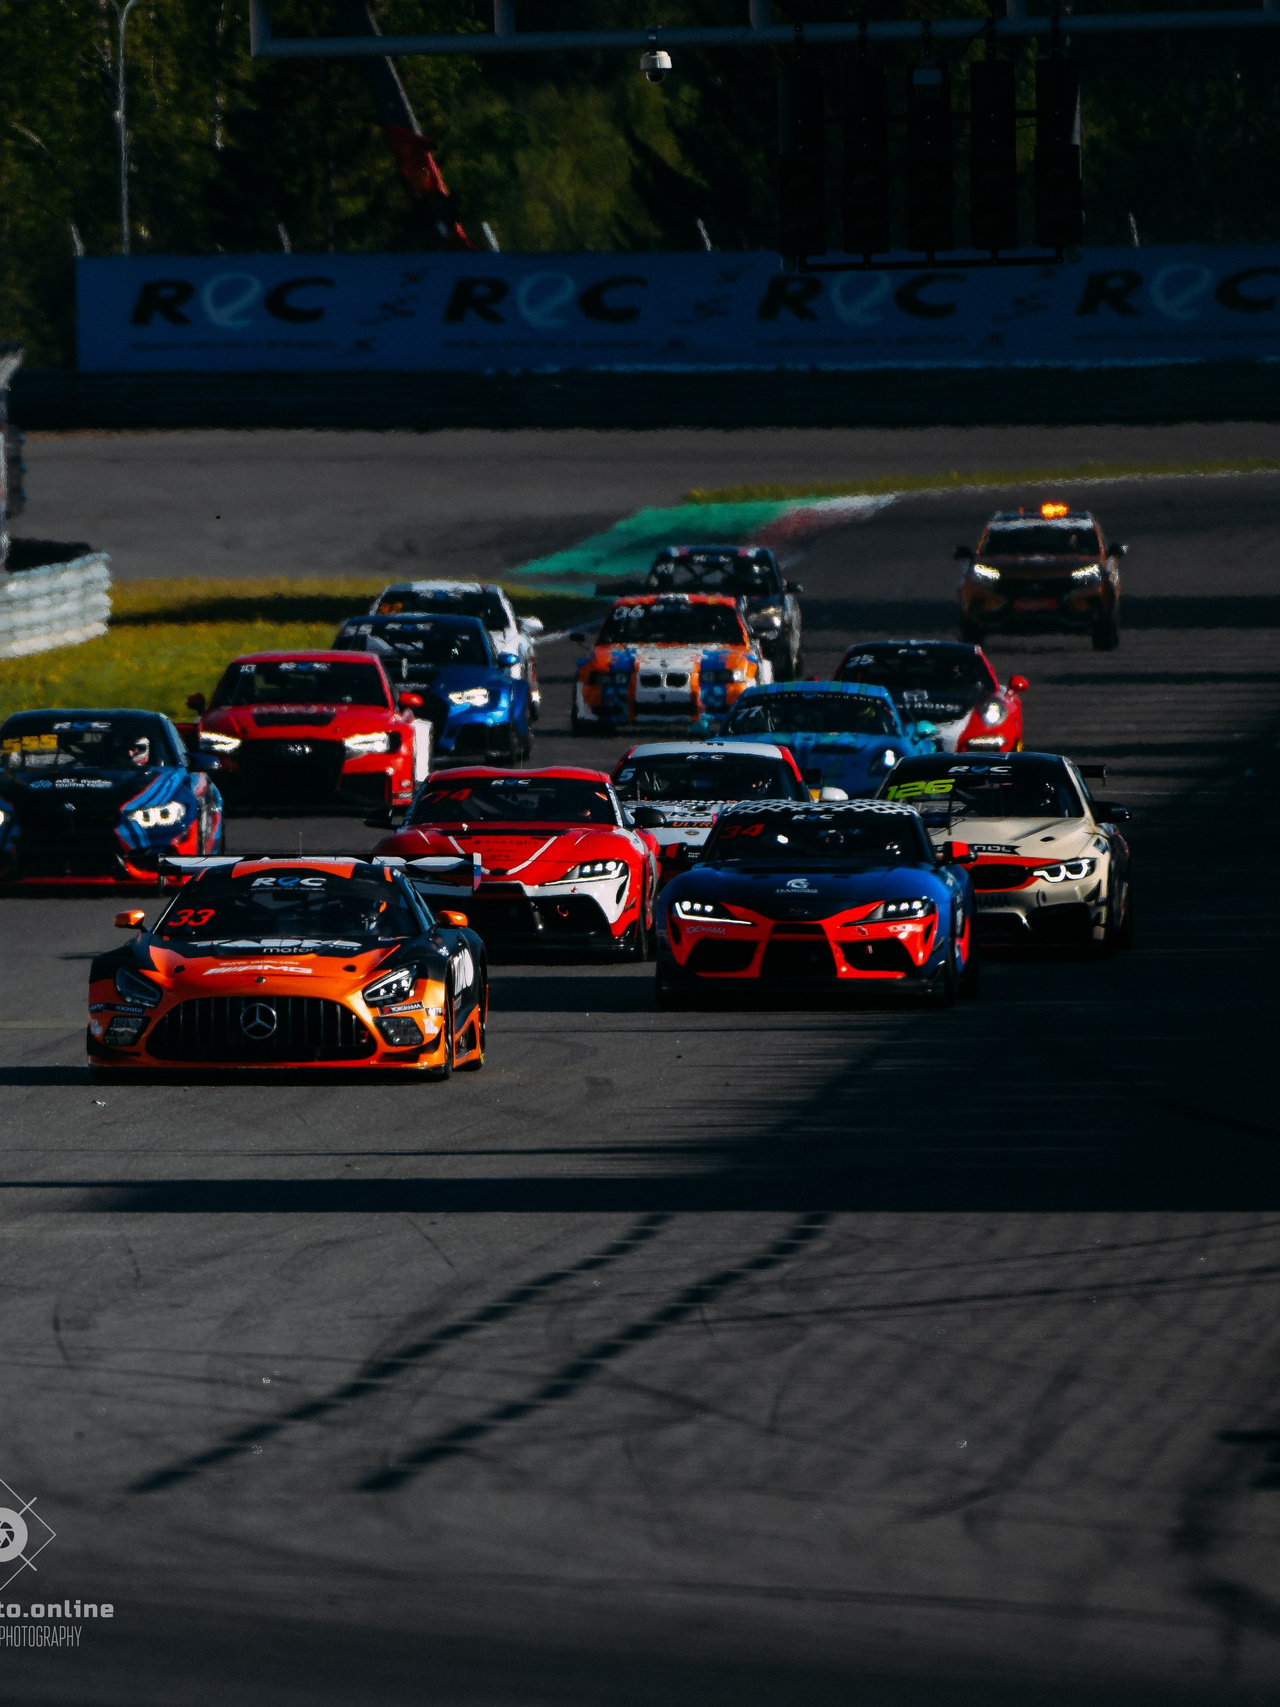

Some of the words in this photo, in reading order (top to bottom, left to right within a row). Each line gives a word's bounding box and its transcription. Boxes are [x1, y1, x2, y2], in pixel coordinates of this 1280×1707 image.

[886, 778, 956, 801] 126
[718, 823, 766, 841] 34
[167, 908, 217, 927] 33
